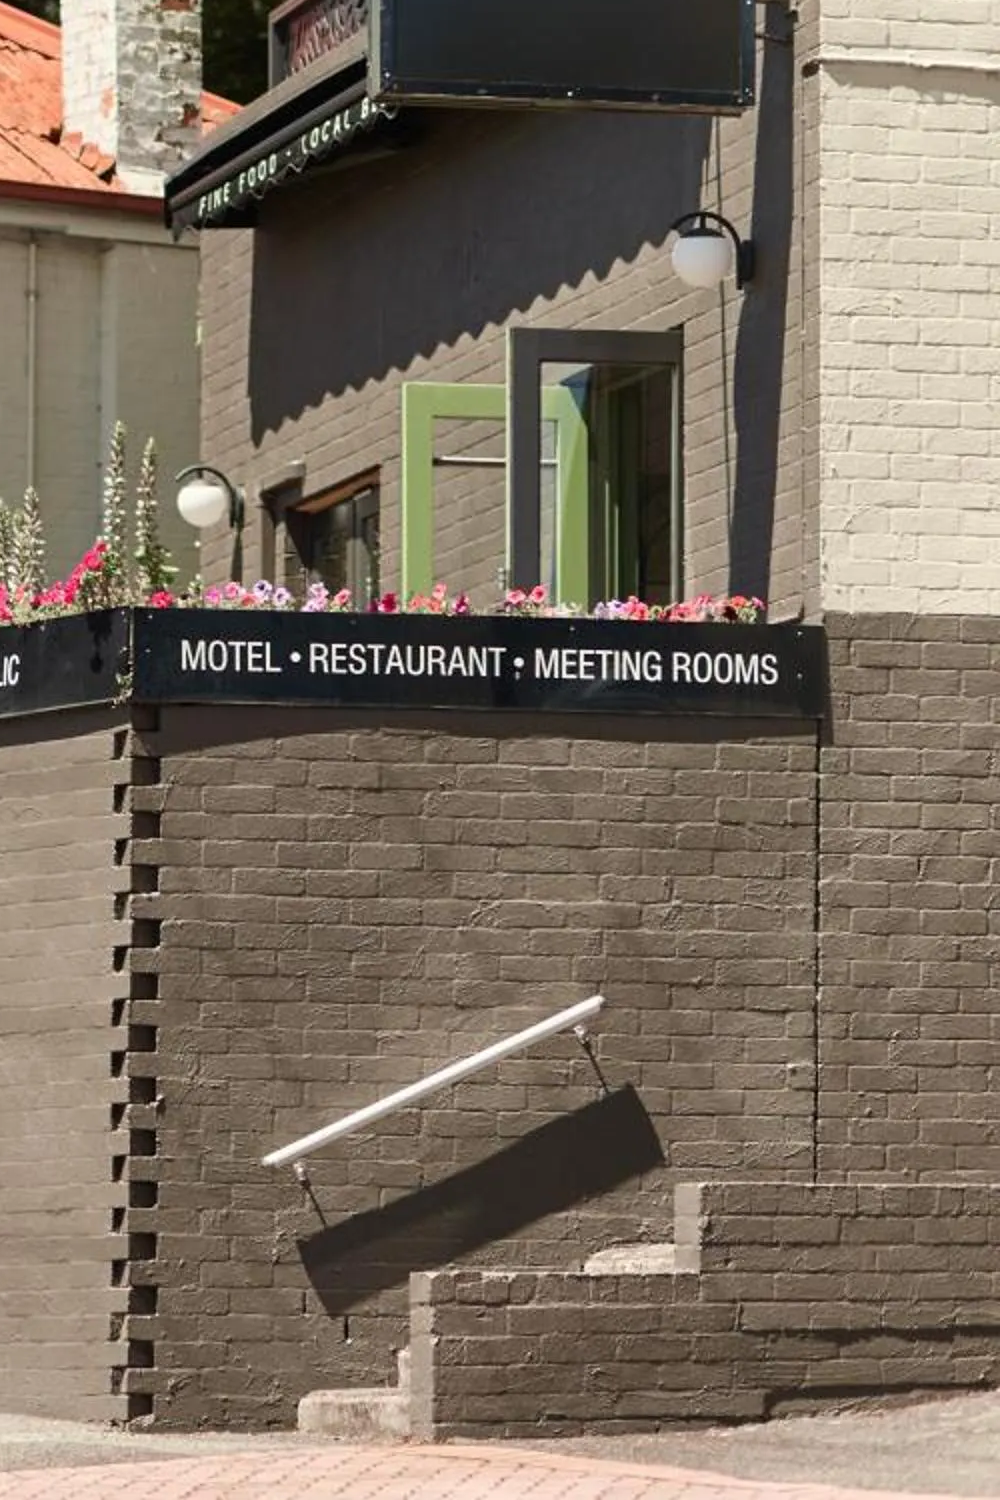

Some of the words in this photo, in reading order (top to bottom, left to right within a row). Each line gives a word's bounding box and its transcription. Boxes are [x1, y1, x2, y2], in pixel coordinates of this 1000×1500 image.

[198, 181, 231, 218] FINE
[238, 153, 278, 194] FOOD
[301, 108, 351, 154] LOCAL
[180, 639, 282, 673] MOTEL
[308, 642, 507, 677] RESTAURANT
[534, 648, 664, 682] MEETING
[671, 651, 780, 685] ROOMS
